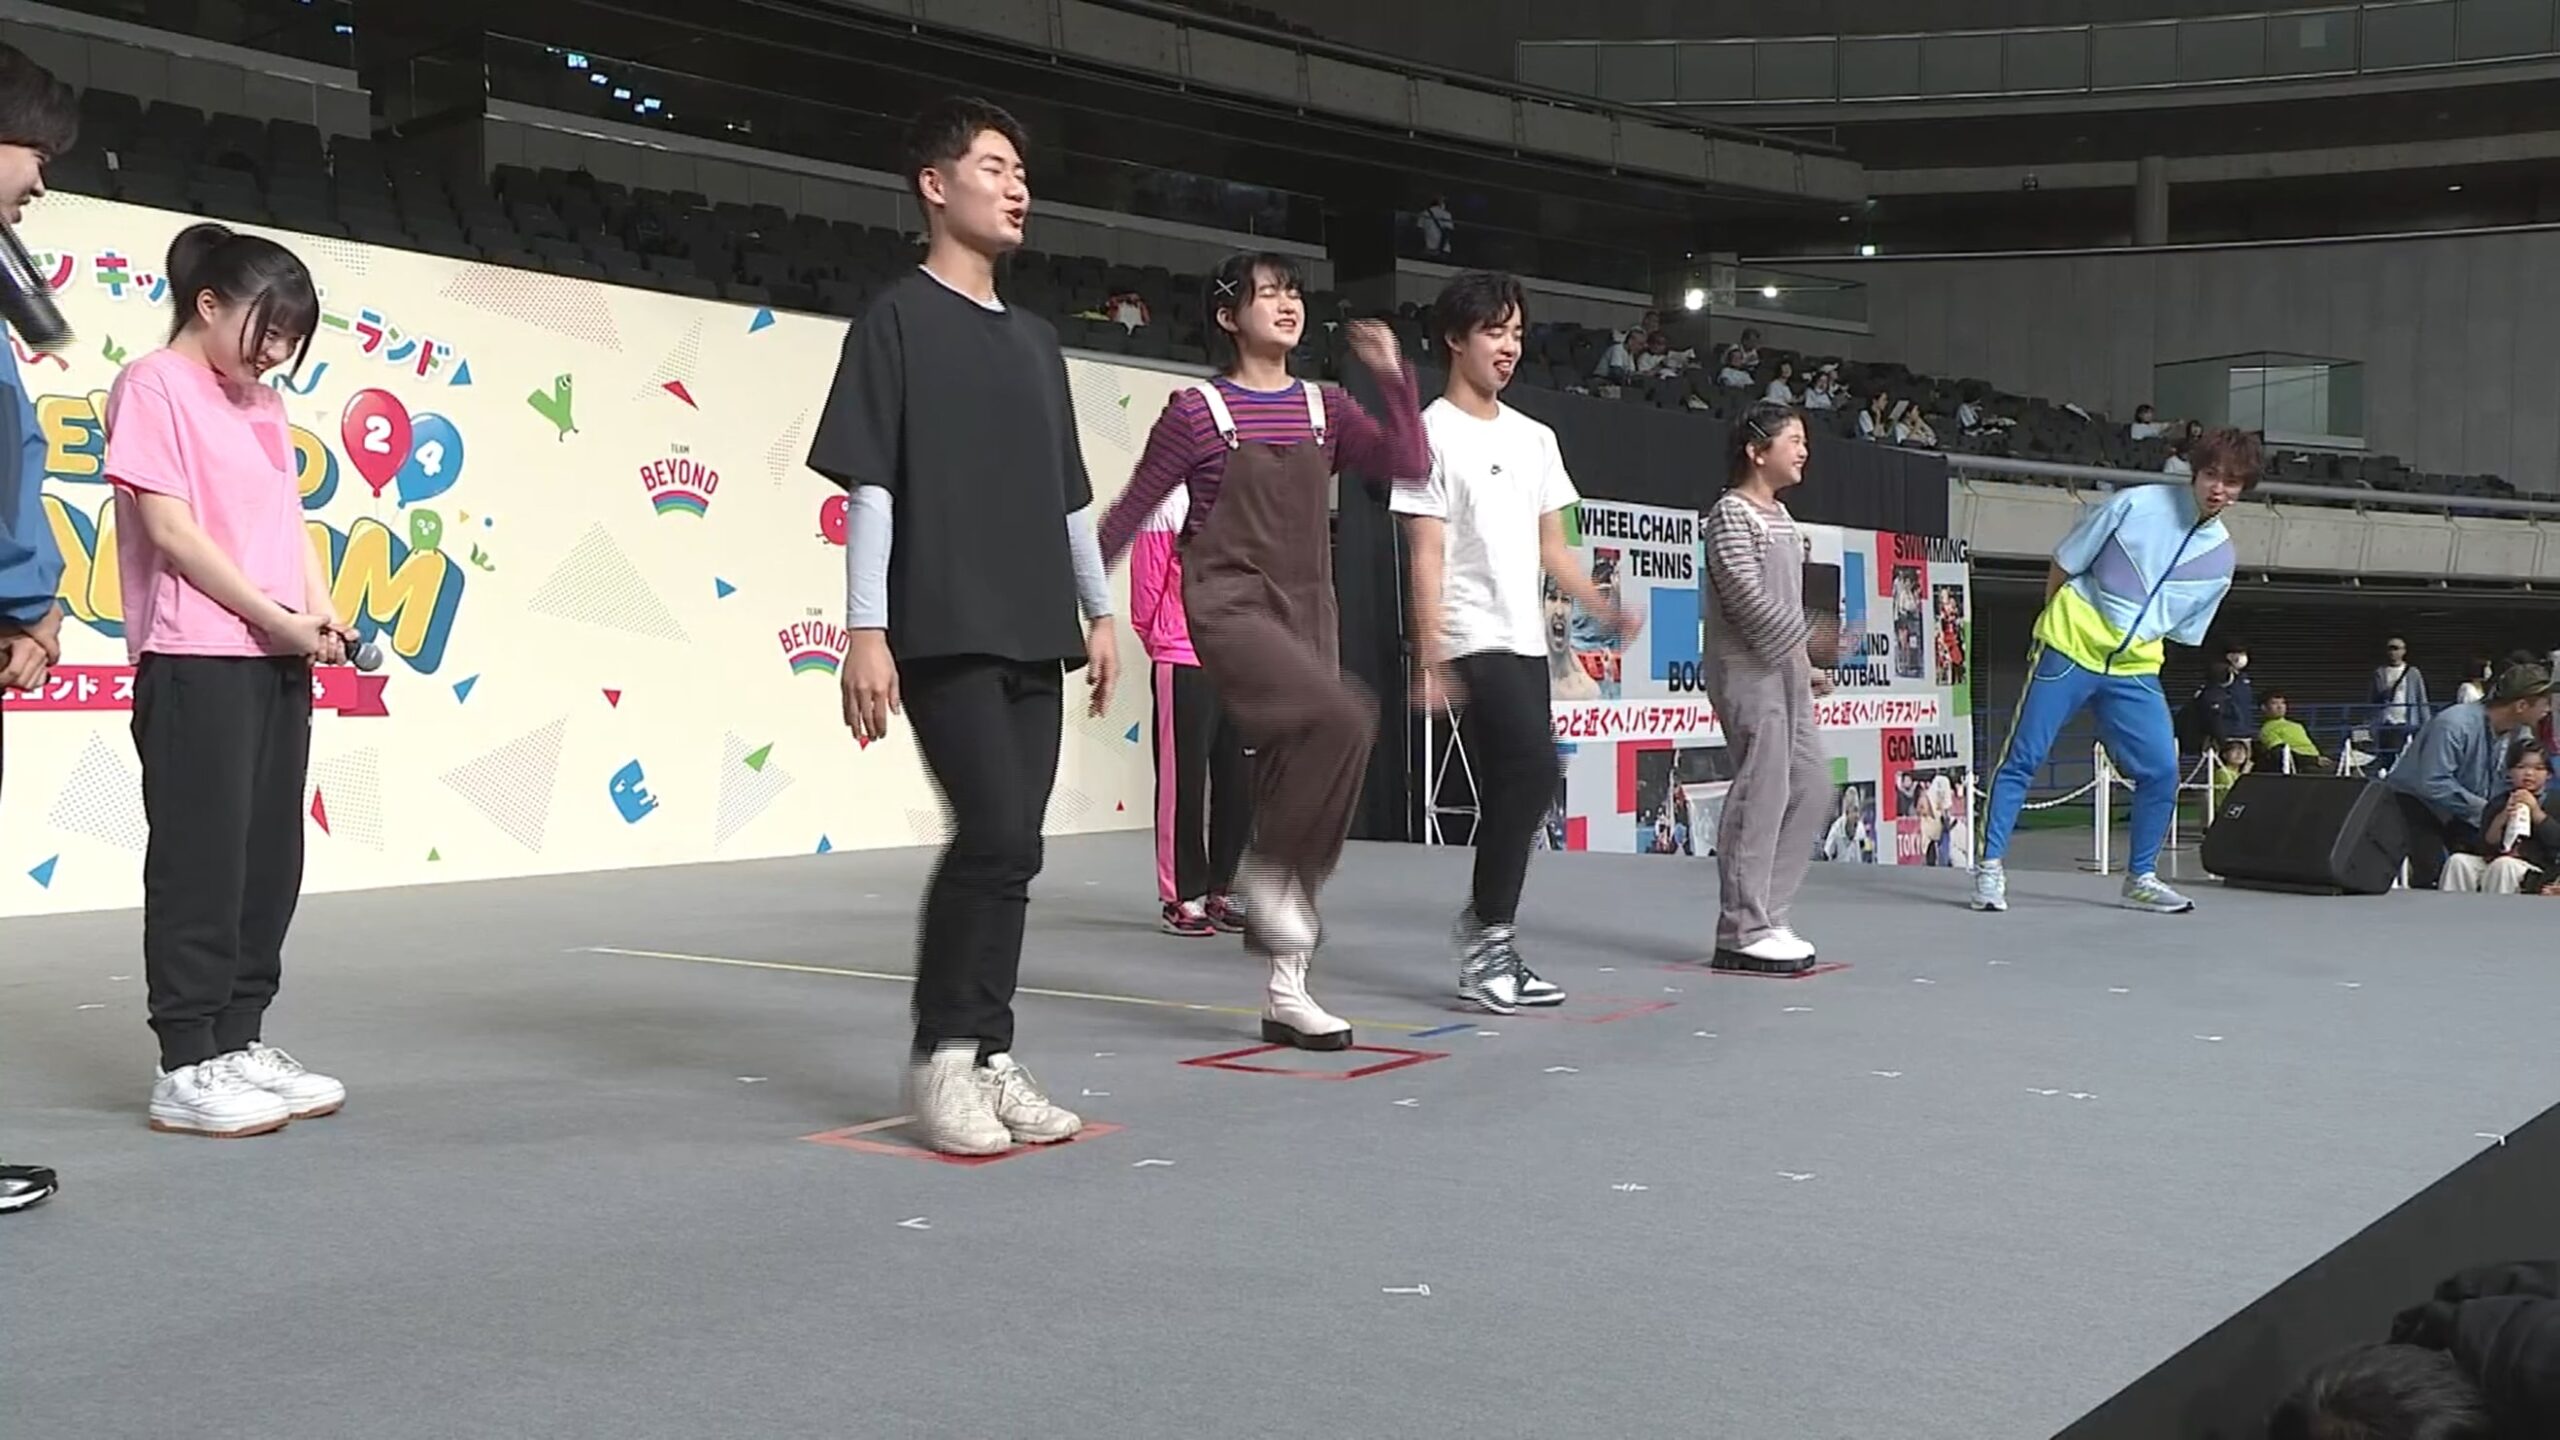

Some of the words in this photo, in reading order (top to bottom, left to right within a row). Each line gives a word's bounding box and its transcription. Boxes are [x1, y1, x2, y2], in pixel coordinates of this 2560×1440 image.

[640, 458, 719, 495] BEYOND
[1574, 507, 1693, 545] WHEELCHAIR
[1629, 549, 1693, 580] TENNIS
[1894, 533, 1968, 564] SWIMMING
[779, 620, 850, 653] BEYOND
[1855, 633, 1890, 657] LIND
[1551, 704, 1720, 737] っと近くへ!パラアスリート
[1887, 733, 1958, 762] GOALBALL
